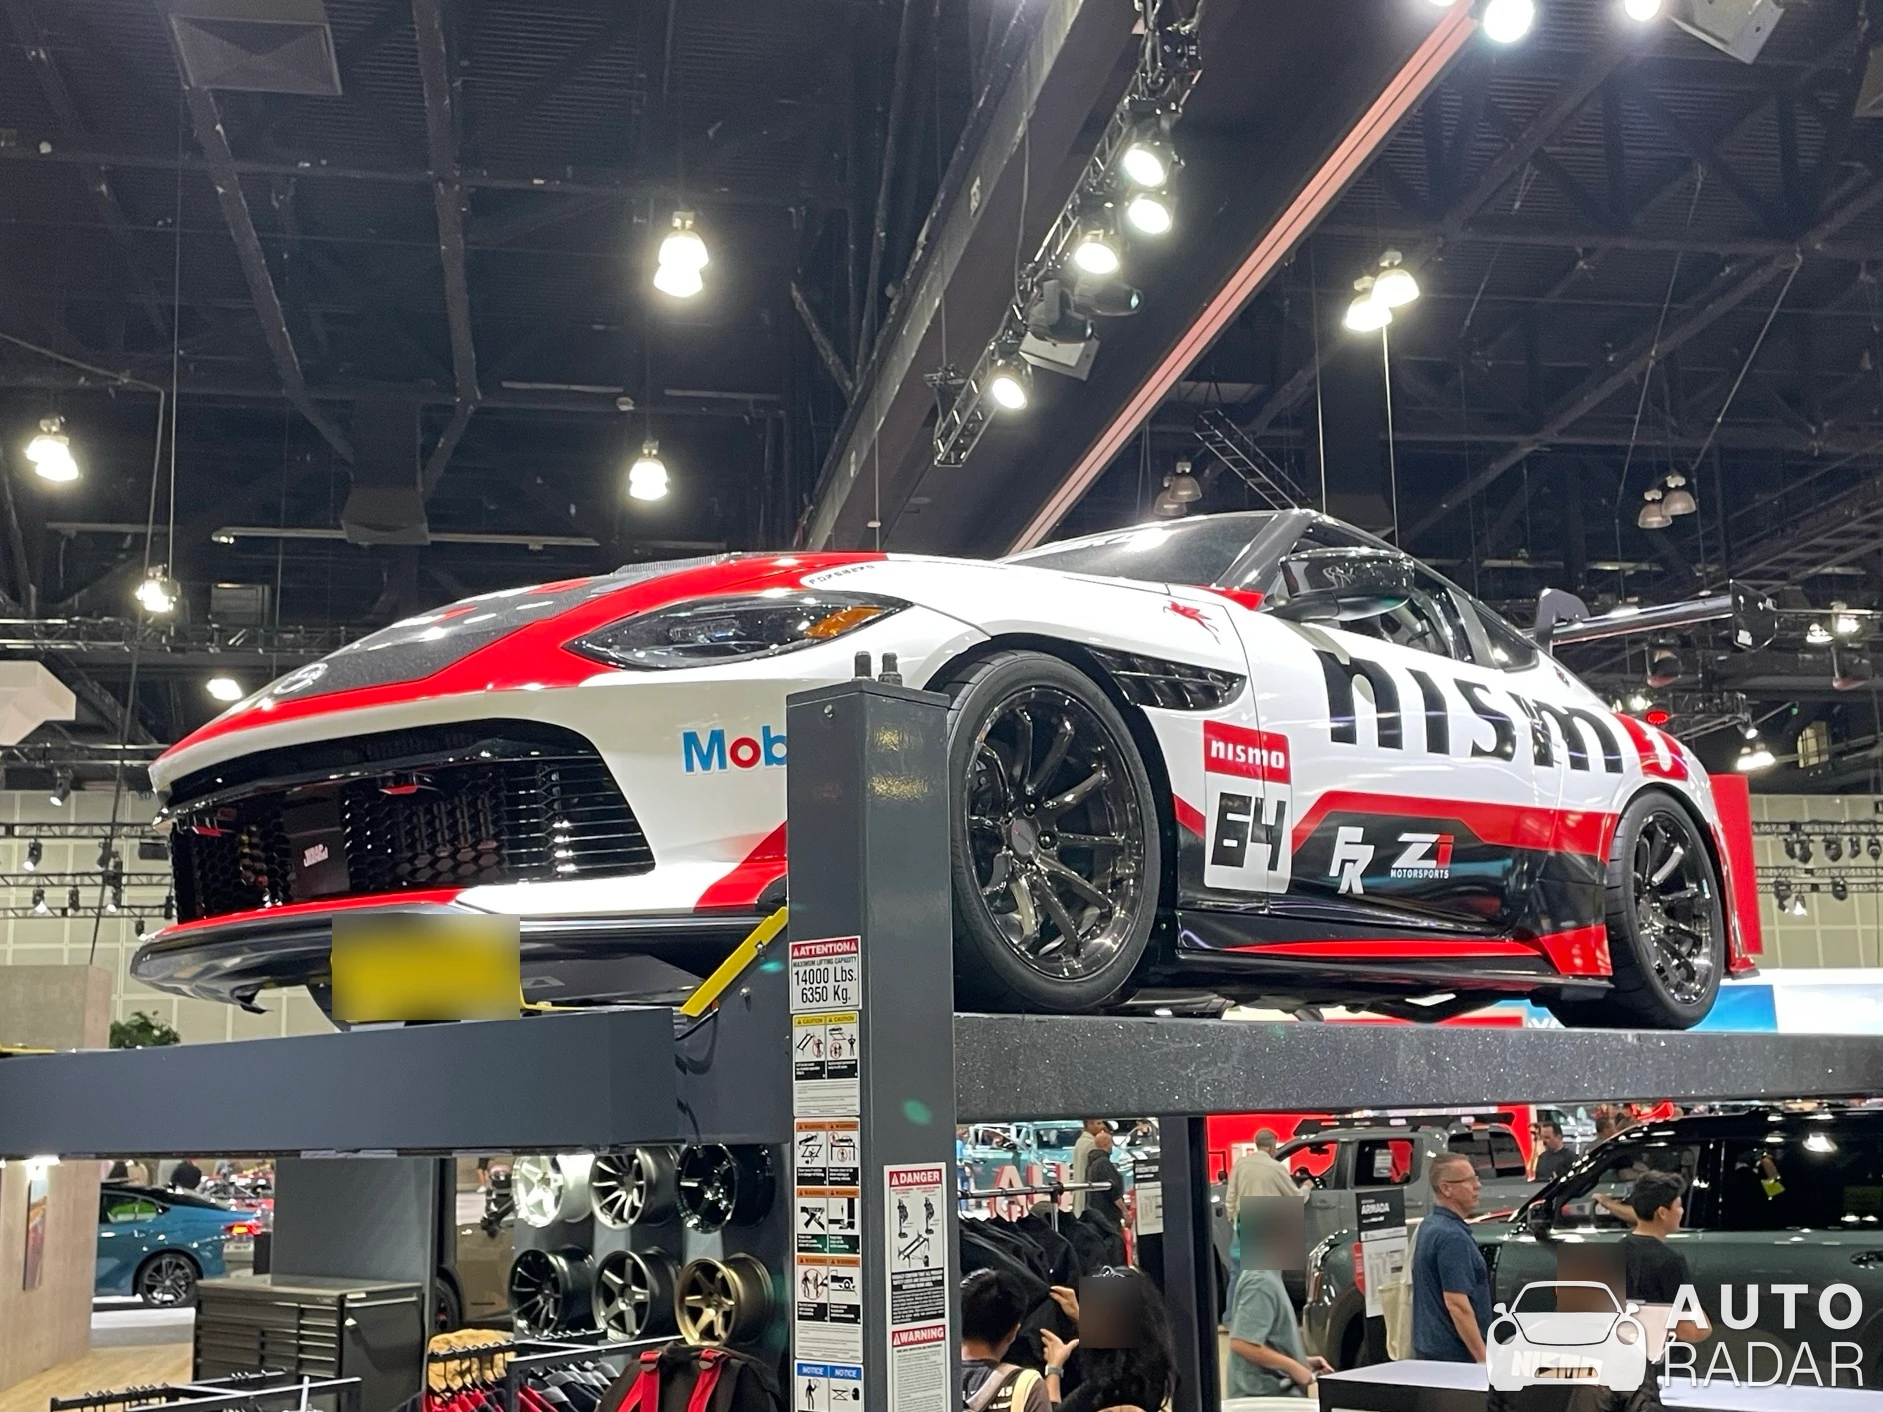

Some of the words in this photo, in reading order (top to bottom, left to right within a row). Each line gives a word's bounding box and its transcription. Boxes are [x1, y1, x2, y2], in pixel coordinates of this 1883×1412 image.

[1210, 739, 1286, 770] nismo
[1211, 791, 1287, 873] 64
[1390, 868, 1450, 880] MOTORSPORTS
[799, 942, 850, 956] ATTENTION
[816, 958, 834, 966] LIFTING
[834, 956, 857, 965] CAPACITY
[794, 967, 829, 986] 14000
[833, 966, 857, 983] Lbs.
[801, 985, 828, 1004] 6350
[833, 984, 851, 1005] Kg.
[899, 1171, 941, 1184] DANGER
[899, 1327, 944, 1343] WARNING
[802, 1366, 824, 1375] NOTICE
[835, 1368, 857, 1377] NOTICE
